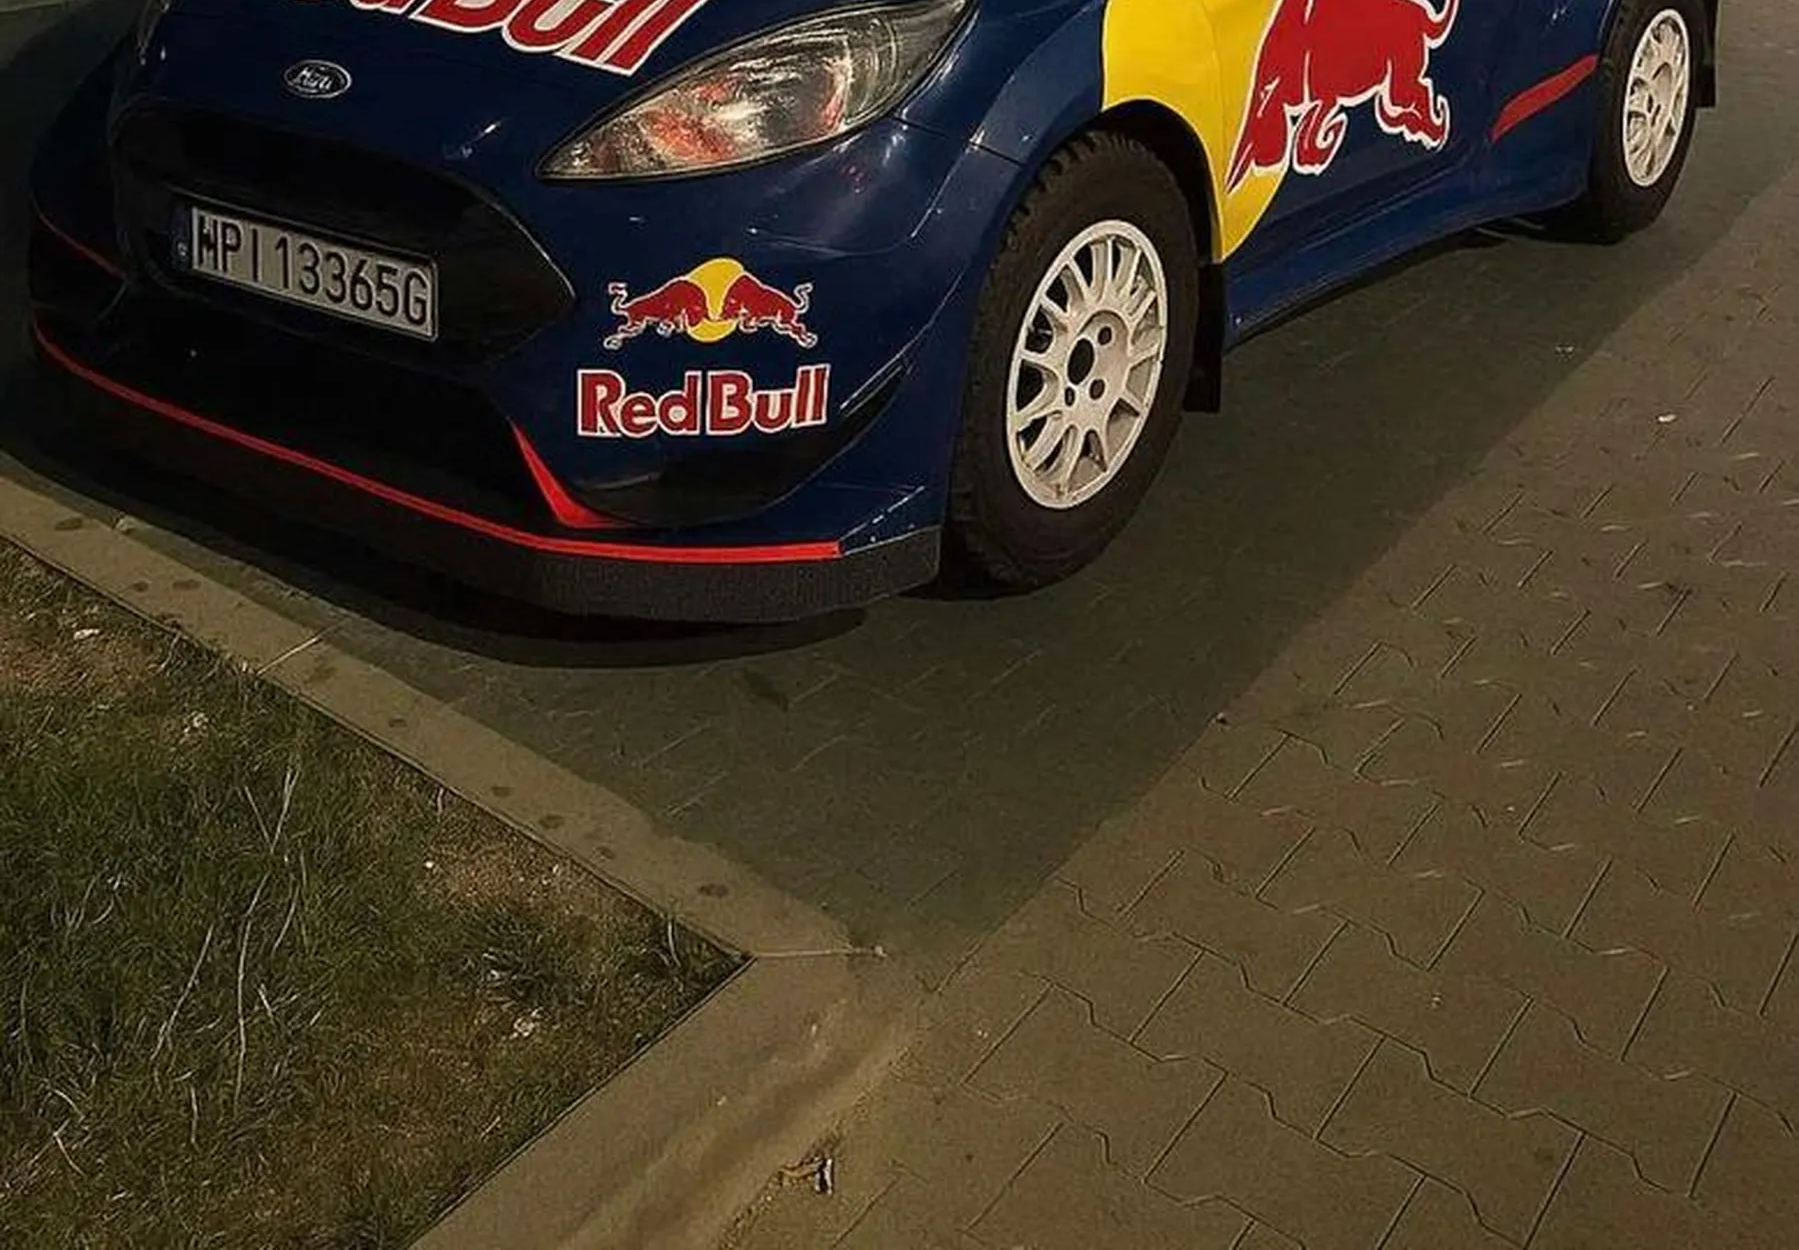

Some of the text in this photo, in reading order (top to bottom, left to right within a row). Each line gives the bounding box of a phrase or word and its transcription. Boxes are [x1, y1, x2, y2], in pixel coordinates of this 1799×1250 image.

[275, 235, 428, 327] 13365G
[577, 363, 832, 439] Red Bull
